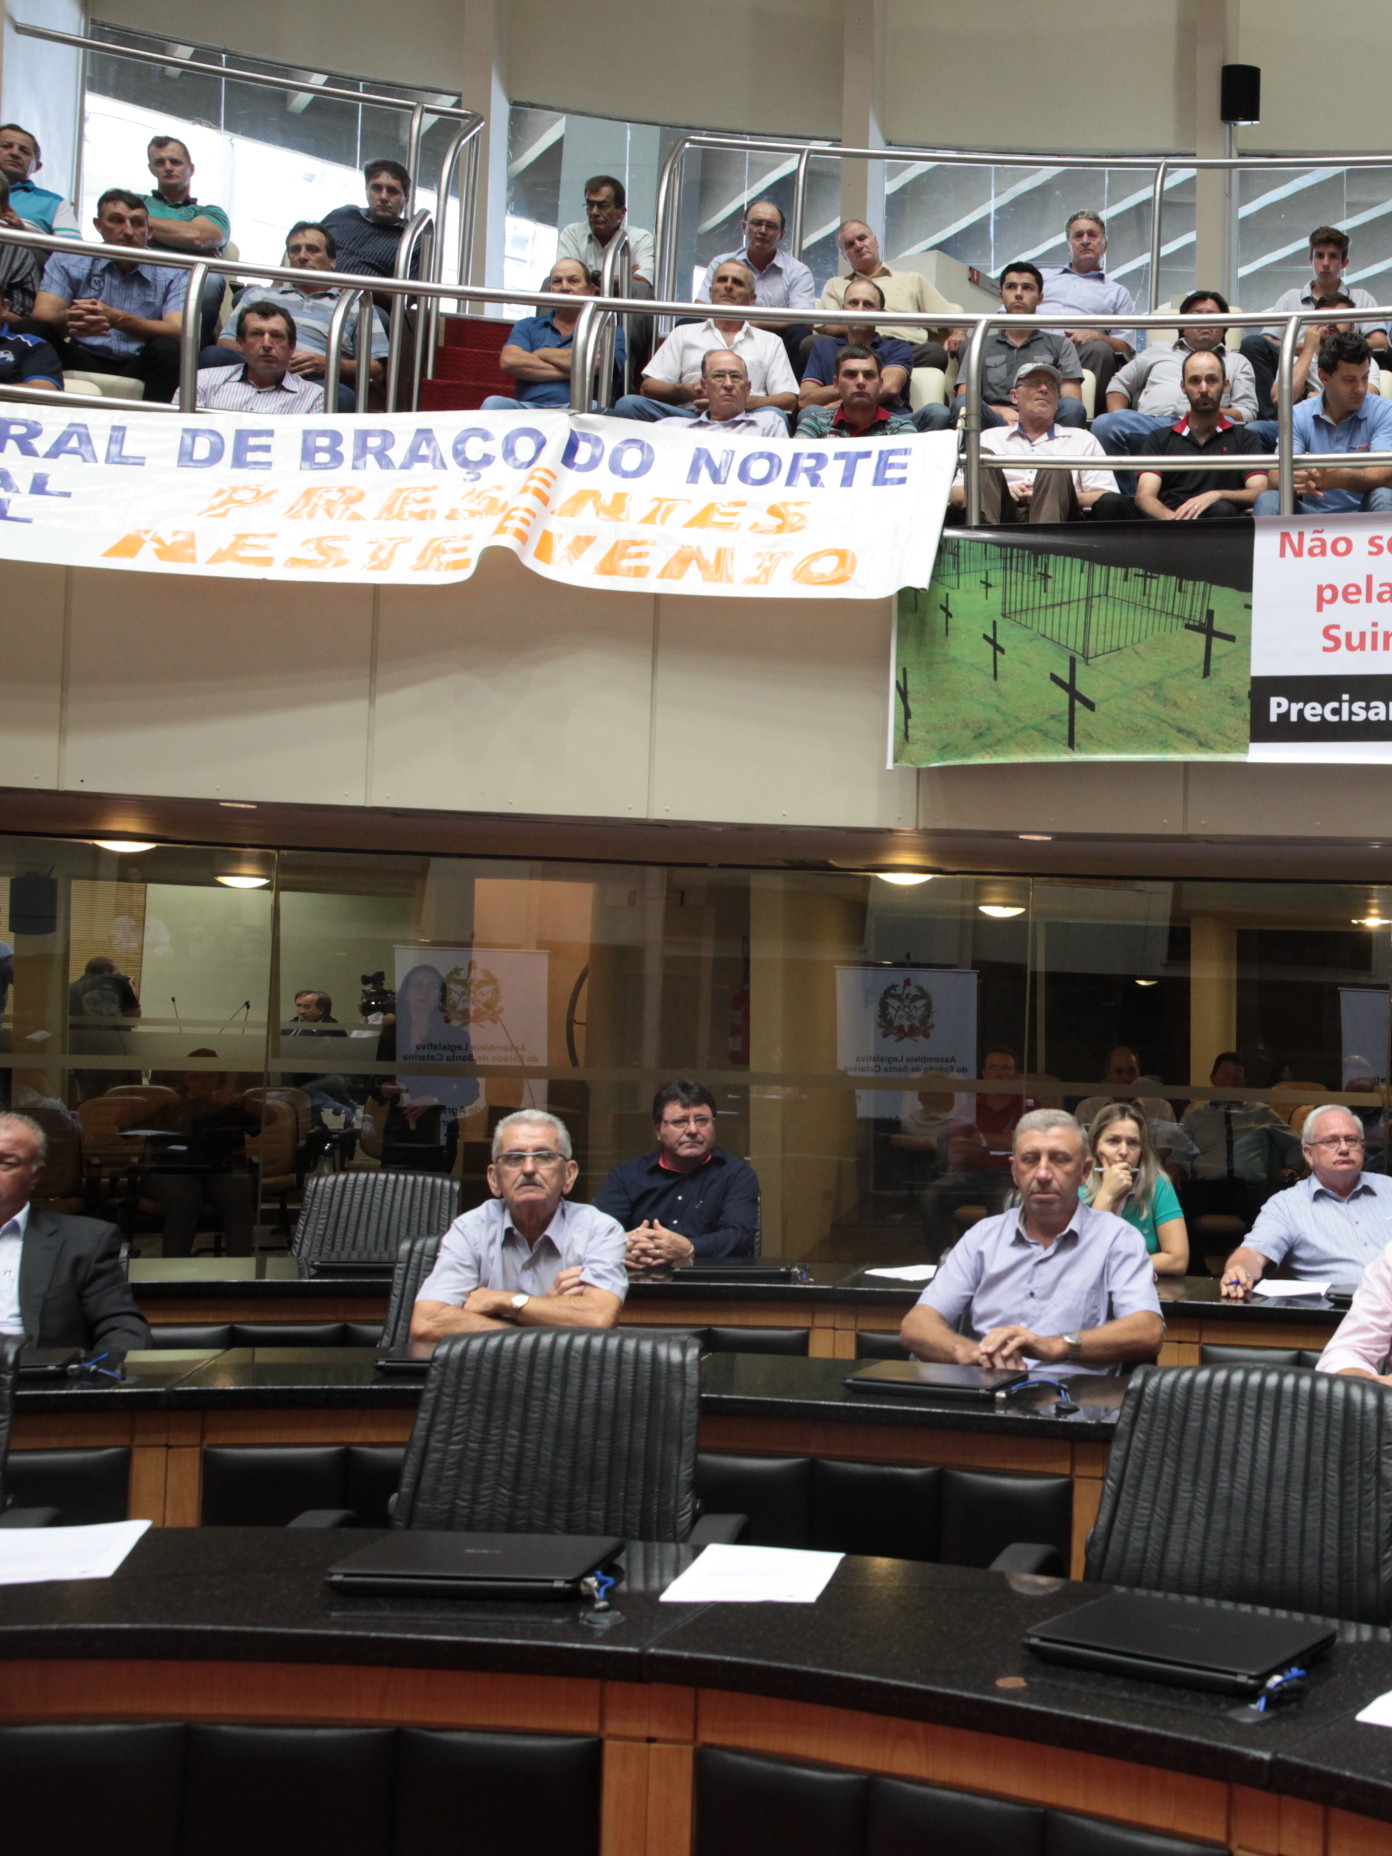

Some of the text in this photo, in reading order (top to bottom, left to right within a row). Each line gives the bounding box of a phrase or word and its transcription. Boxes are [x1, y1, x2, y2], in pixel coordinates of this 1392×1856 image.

[0, 416, 912, 488] RAL DE BRAÇO DO NORTE
[100, 529, 474, 572] NESTE
[1278, 527, 1354, 558] Não
